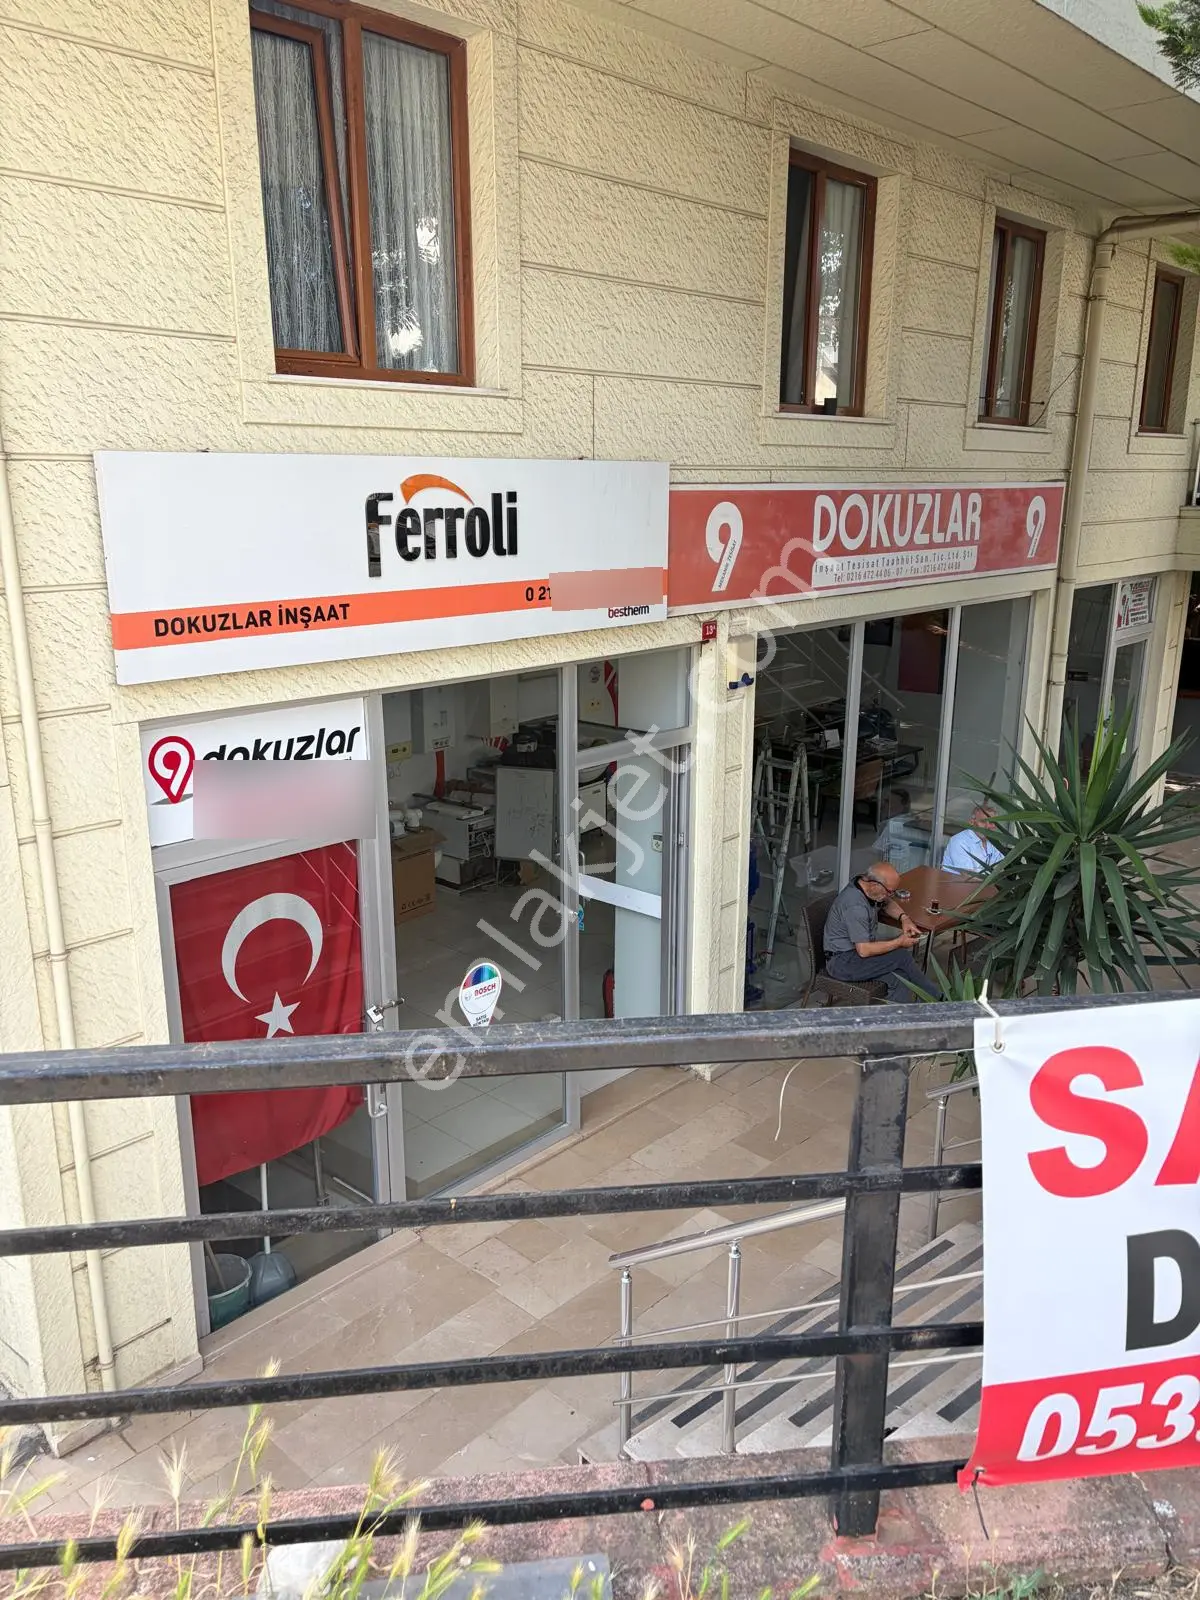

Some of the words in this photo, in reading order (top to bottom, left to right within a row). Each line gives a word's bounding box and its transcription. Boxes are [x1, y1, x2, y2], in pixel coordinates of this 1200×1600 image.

[365, 491, 518, 578] Ferroli
[706, 501, 744, 592] 9
[812, 492, 982, 553] DOKUZLAR
[1026, 496, 1046, 560] 9
[526, 586, 534, 602] 0
[847, 558, 879, 571] Tesisat
[154, 607, 273, 638] DOKUZLAR
[277, 602, 351, 630] İNŞAAT
[608, 605, 650, 618] bestherm
[1016, 1374, 1200, 1463] 053
